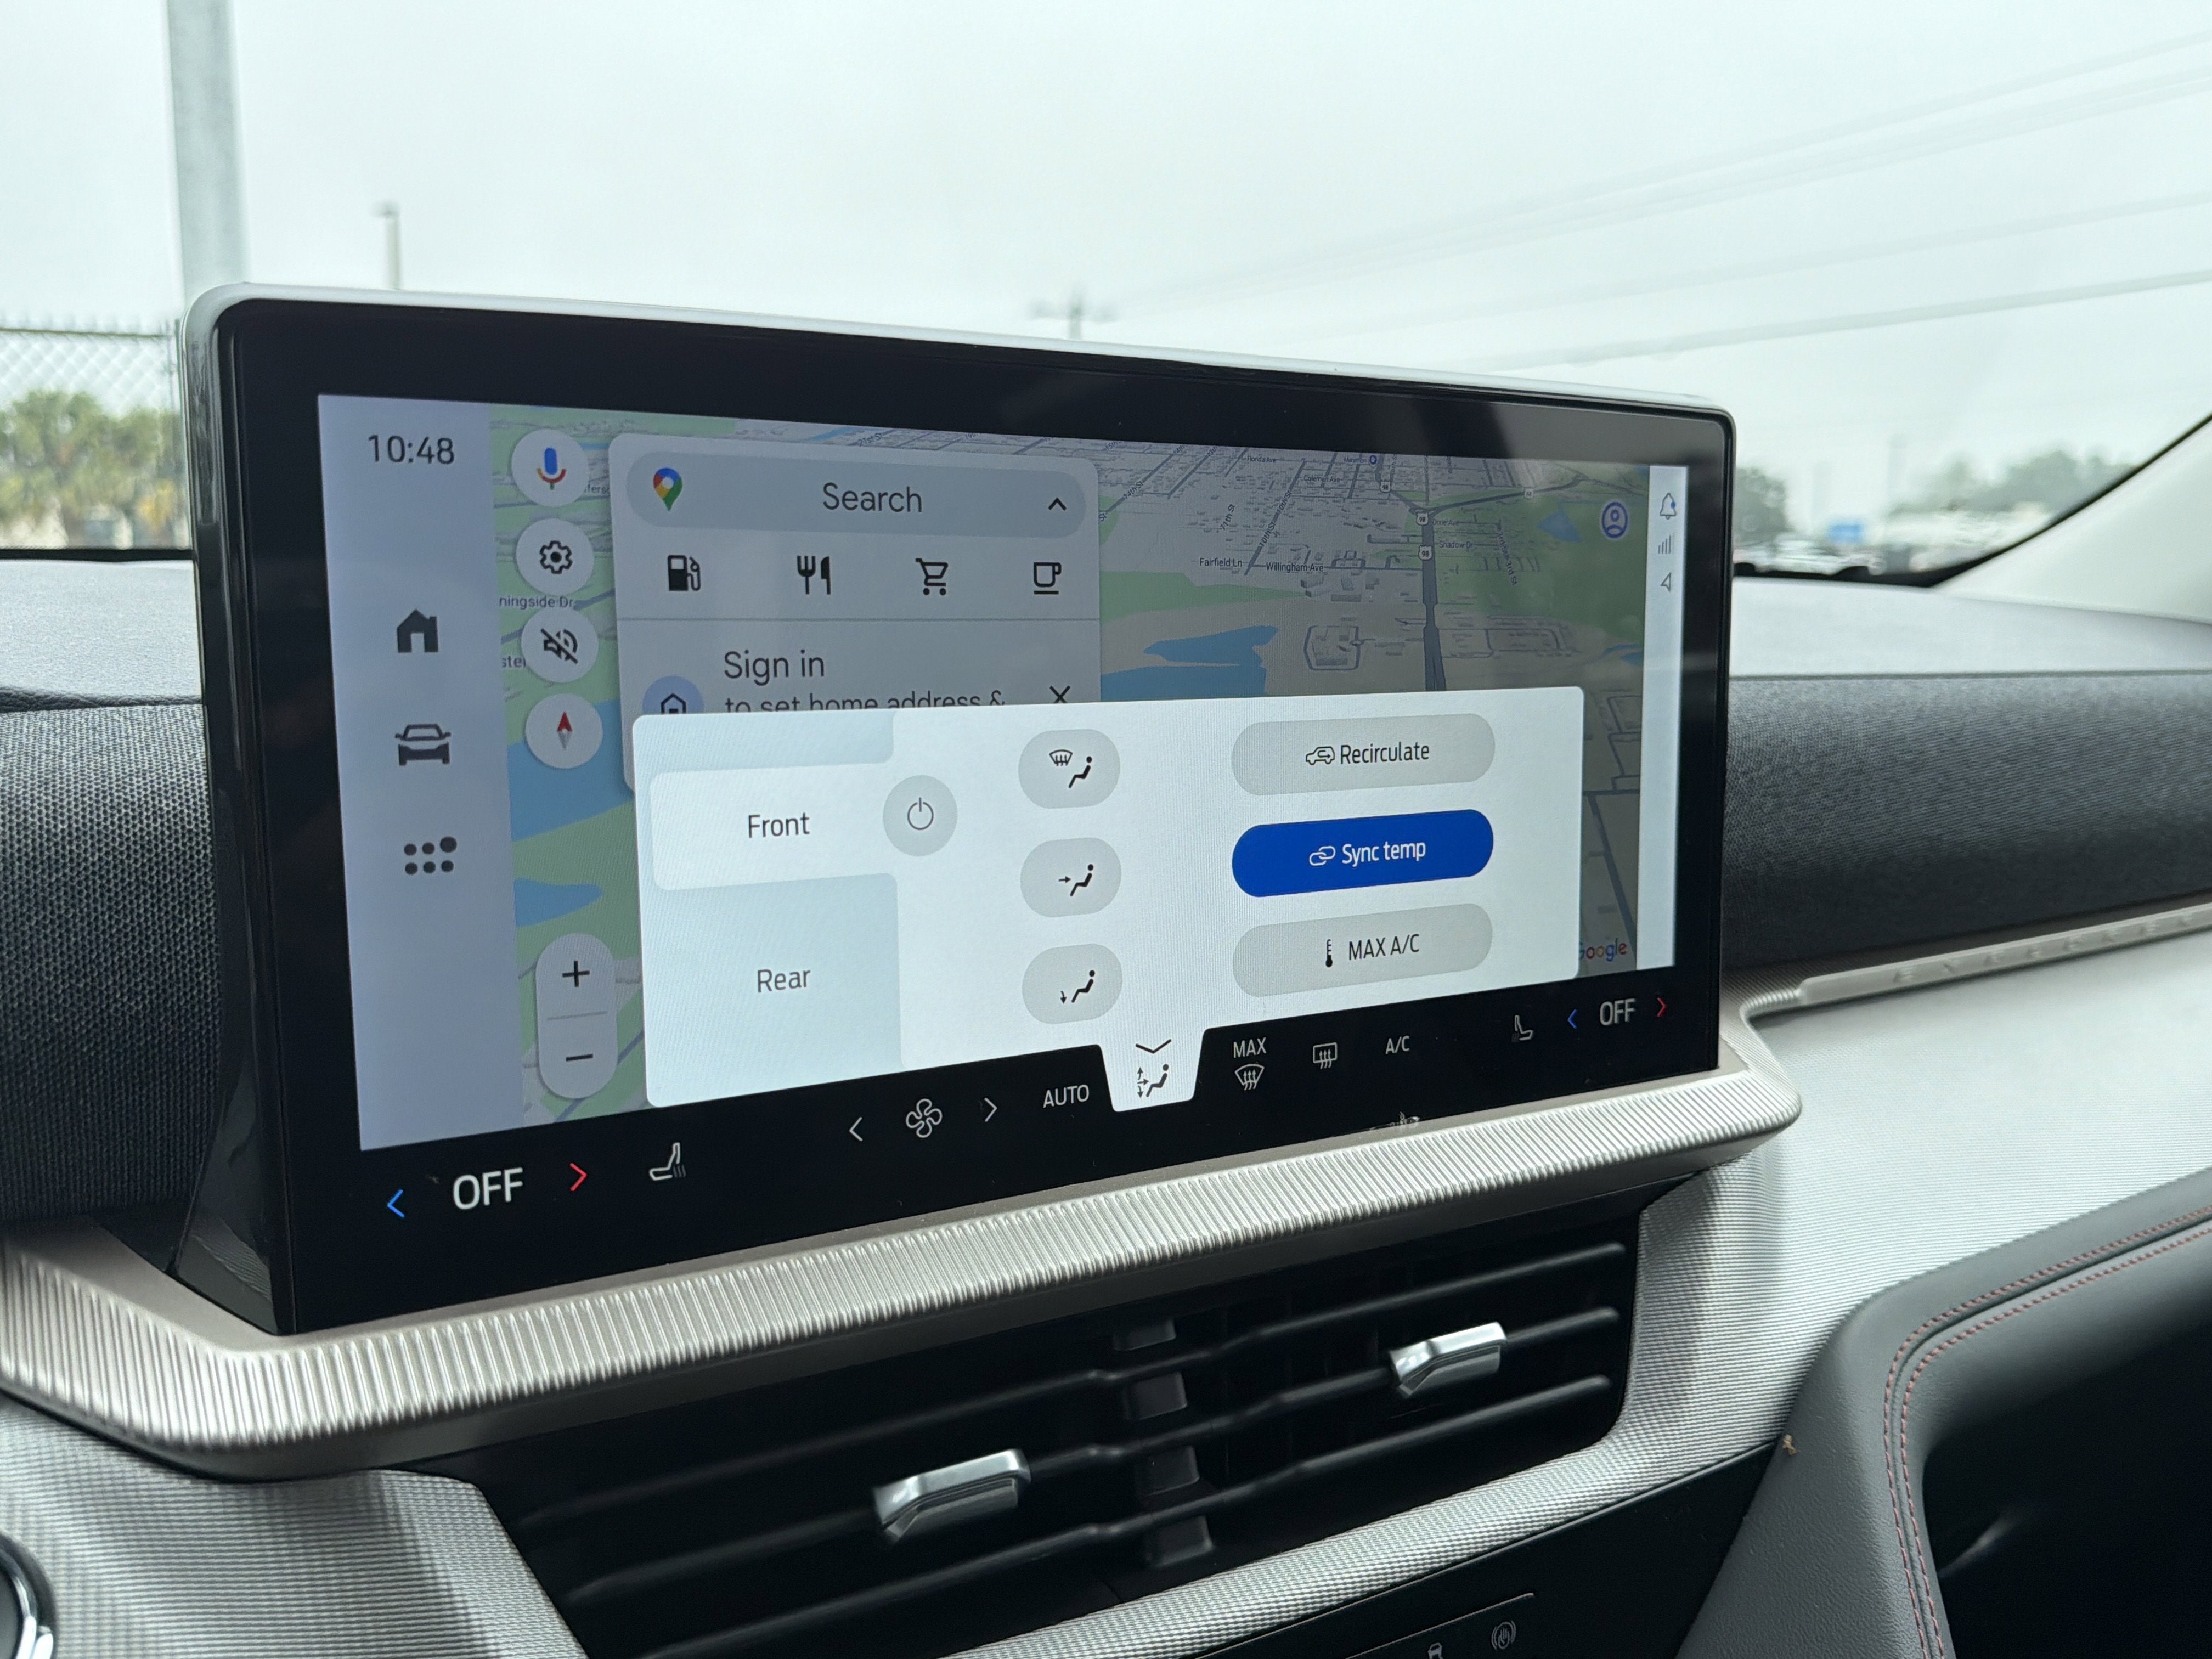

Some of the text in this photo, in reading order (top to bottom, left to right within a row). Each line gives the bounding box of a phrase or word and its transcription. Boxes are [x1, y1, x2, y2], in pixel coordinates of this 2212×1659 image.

[368, 435, 455, 465] 10:48
[823, 482, 922, 512] Search
[1124, 487, 1137, 500] 14th
[1277, 498, 1287, 514] 10th
[1220, 504, 1235, 531] 11th St
[1260, 521, 1277, 548] 10th St
[1200, 557, 1243, 567] Fairfield Ln
[1267, 562, 1307, 573] Willingham
[560, 596, 574, 608] Dr
[724, 650, 825, 686] Sign in
[1340, 741, 1430, 765] Recirculate
[748, 812, 810, 838] Front
[1342, 841, 1426, 867] Sync temp
[1348, 934, 1419, 961] MAX A/C
[757, 969, 811, 993] Rear
[1600, 998, 1636, 1026] OFF
[1233, 1036, 1267, 1059] MAX
[1386, 1035, 1410, 1054] A/C
[1043, 1084, 1090, 1108] AUTO
[453, 1167, 523, 1210] OFF
